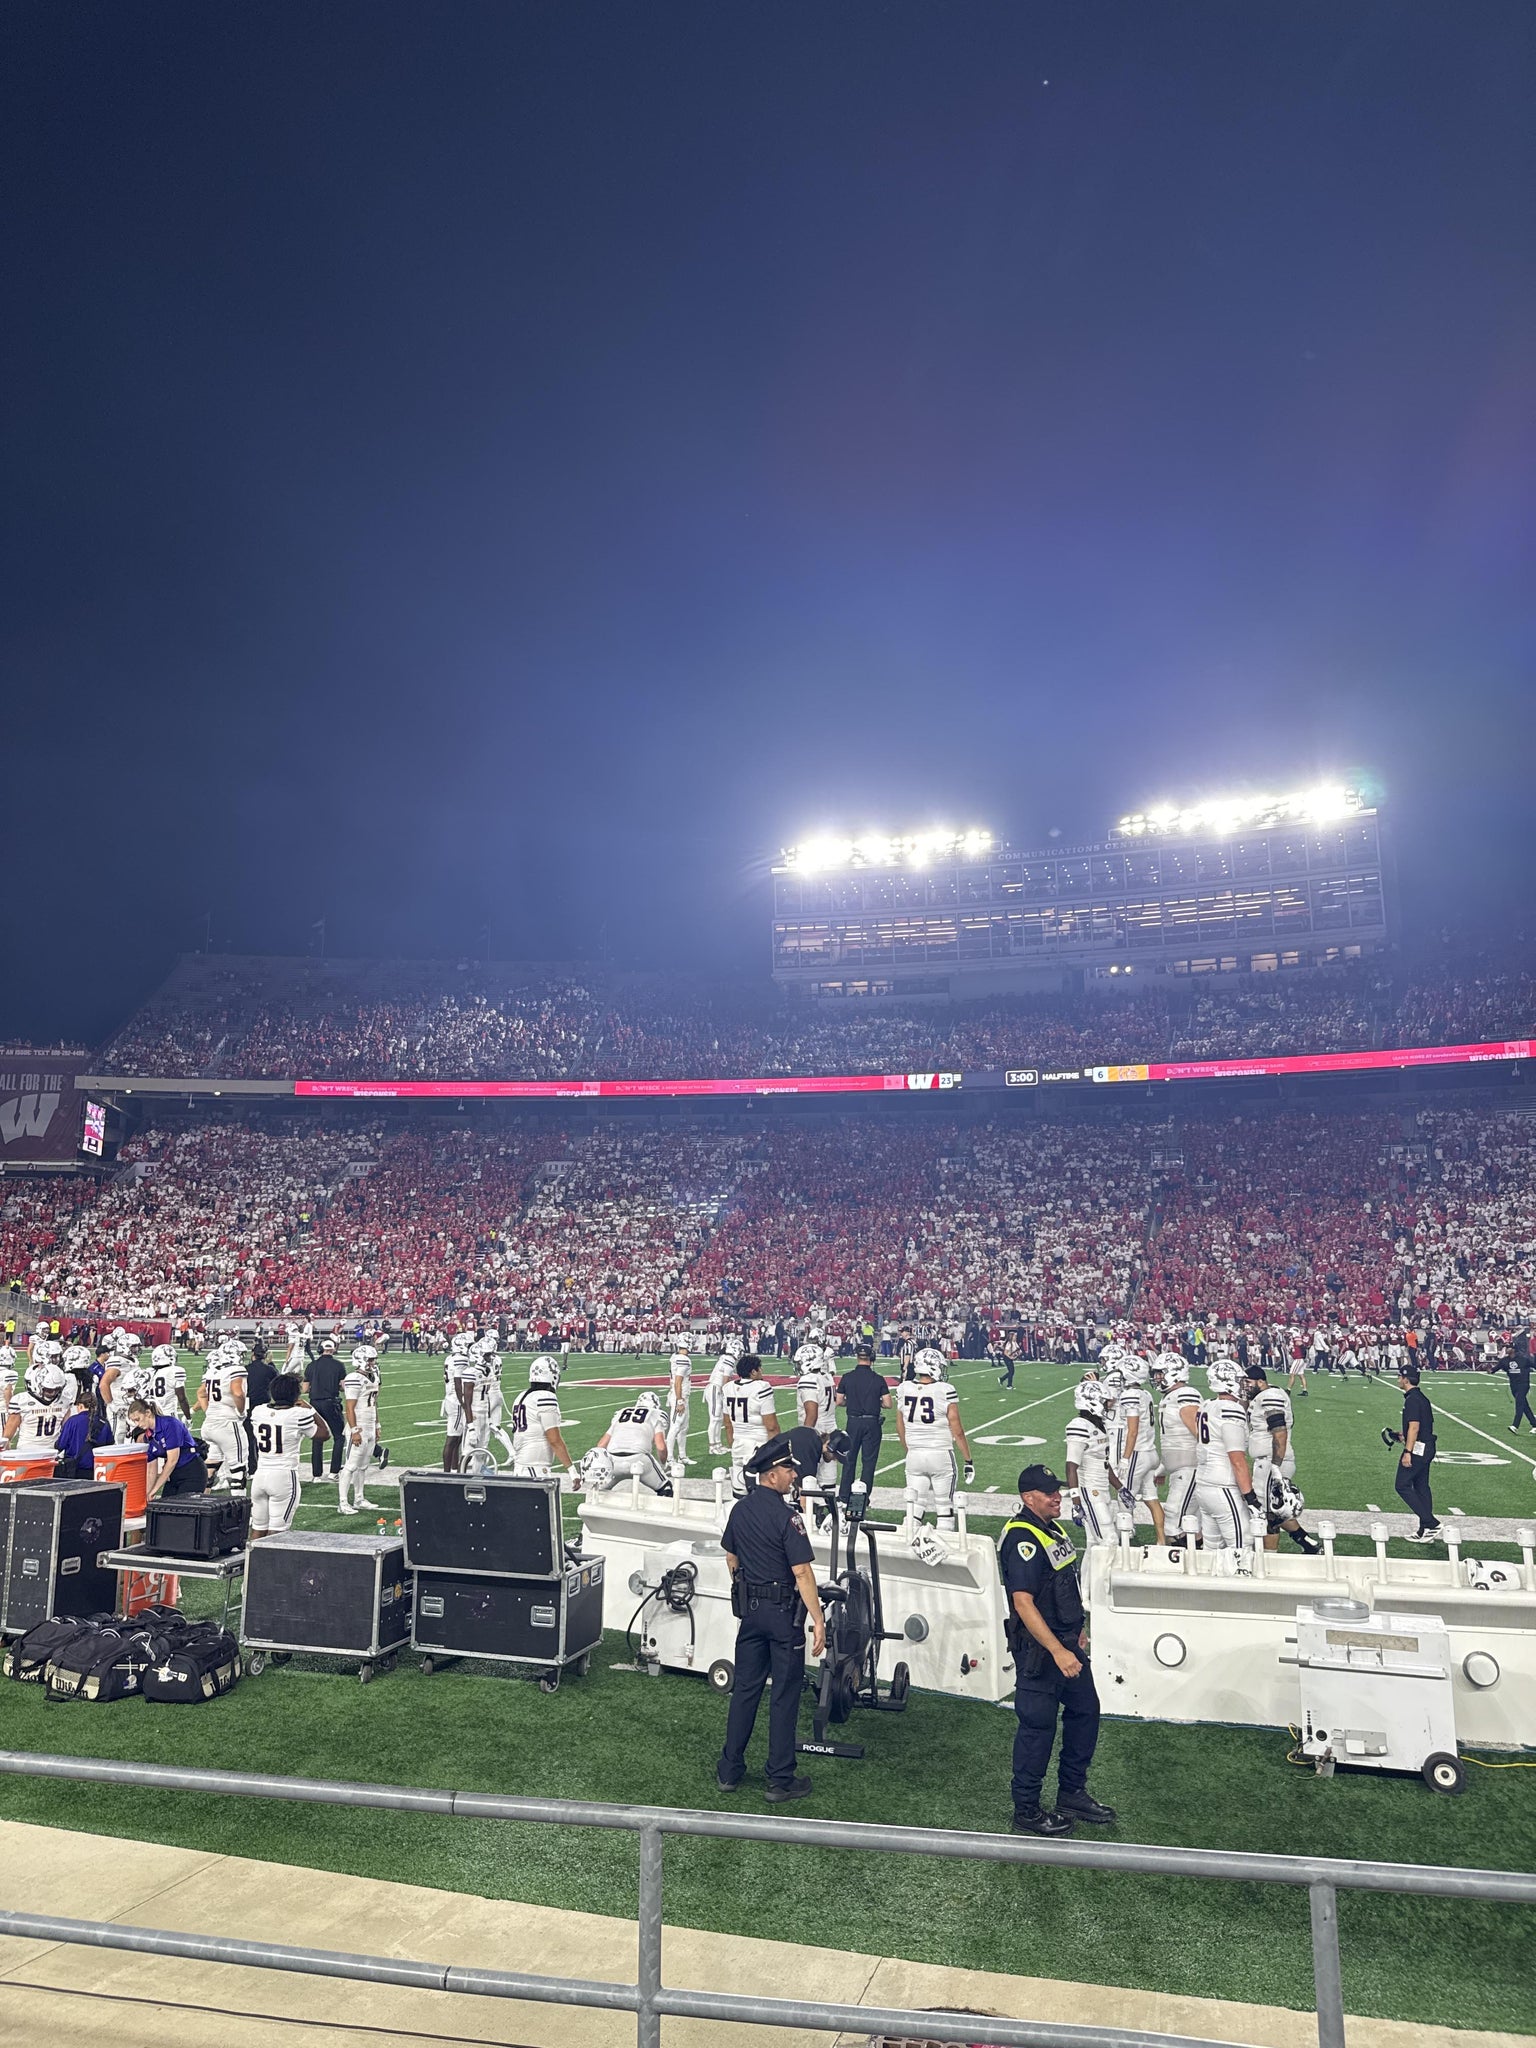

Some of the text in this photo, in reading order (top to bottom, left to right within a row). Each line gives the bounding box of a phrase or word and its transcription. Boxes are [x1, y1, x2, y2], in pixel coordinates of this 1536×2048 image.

[998, 844, 1100, 861] COMMUNICATIONS
[1104, 839, 1150, 850] CENTER
[1042, 1072, 1080, 1081] HALFTIME
[1098, 1071, 1104, 1079] 6
[1192, 1065, 1219, 1073] WRECK
[20, 1074, 40, 1091] FOR
[44, 1075, 63, 1091] THE
[941, 1076, 951, 1085] 23
[1010, 1073, 1034, 1083] 3:00
[205, 1379, 222, 1402] 75
[618, 1408, 649, 1424] 69
[726, 1397, 749, 1423] 77
[904, 1396, 935, 1424] 73
[36, 1415, 57, 1437] 10
[512, 1404, 528, 1433] 50
[258, 1423, 283, 1454] 31
[379, 1527, 386, 1535] G
[1168, 1549, 1181, 1564] G
[1490, 1570, 1508, 1583] G
[55, 1677, 88, 1699] Wilsn
[802, 1743, 835, 1754] ROGUE
